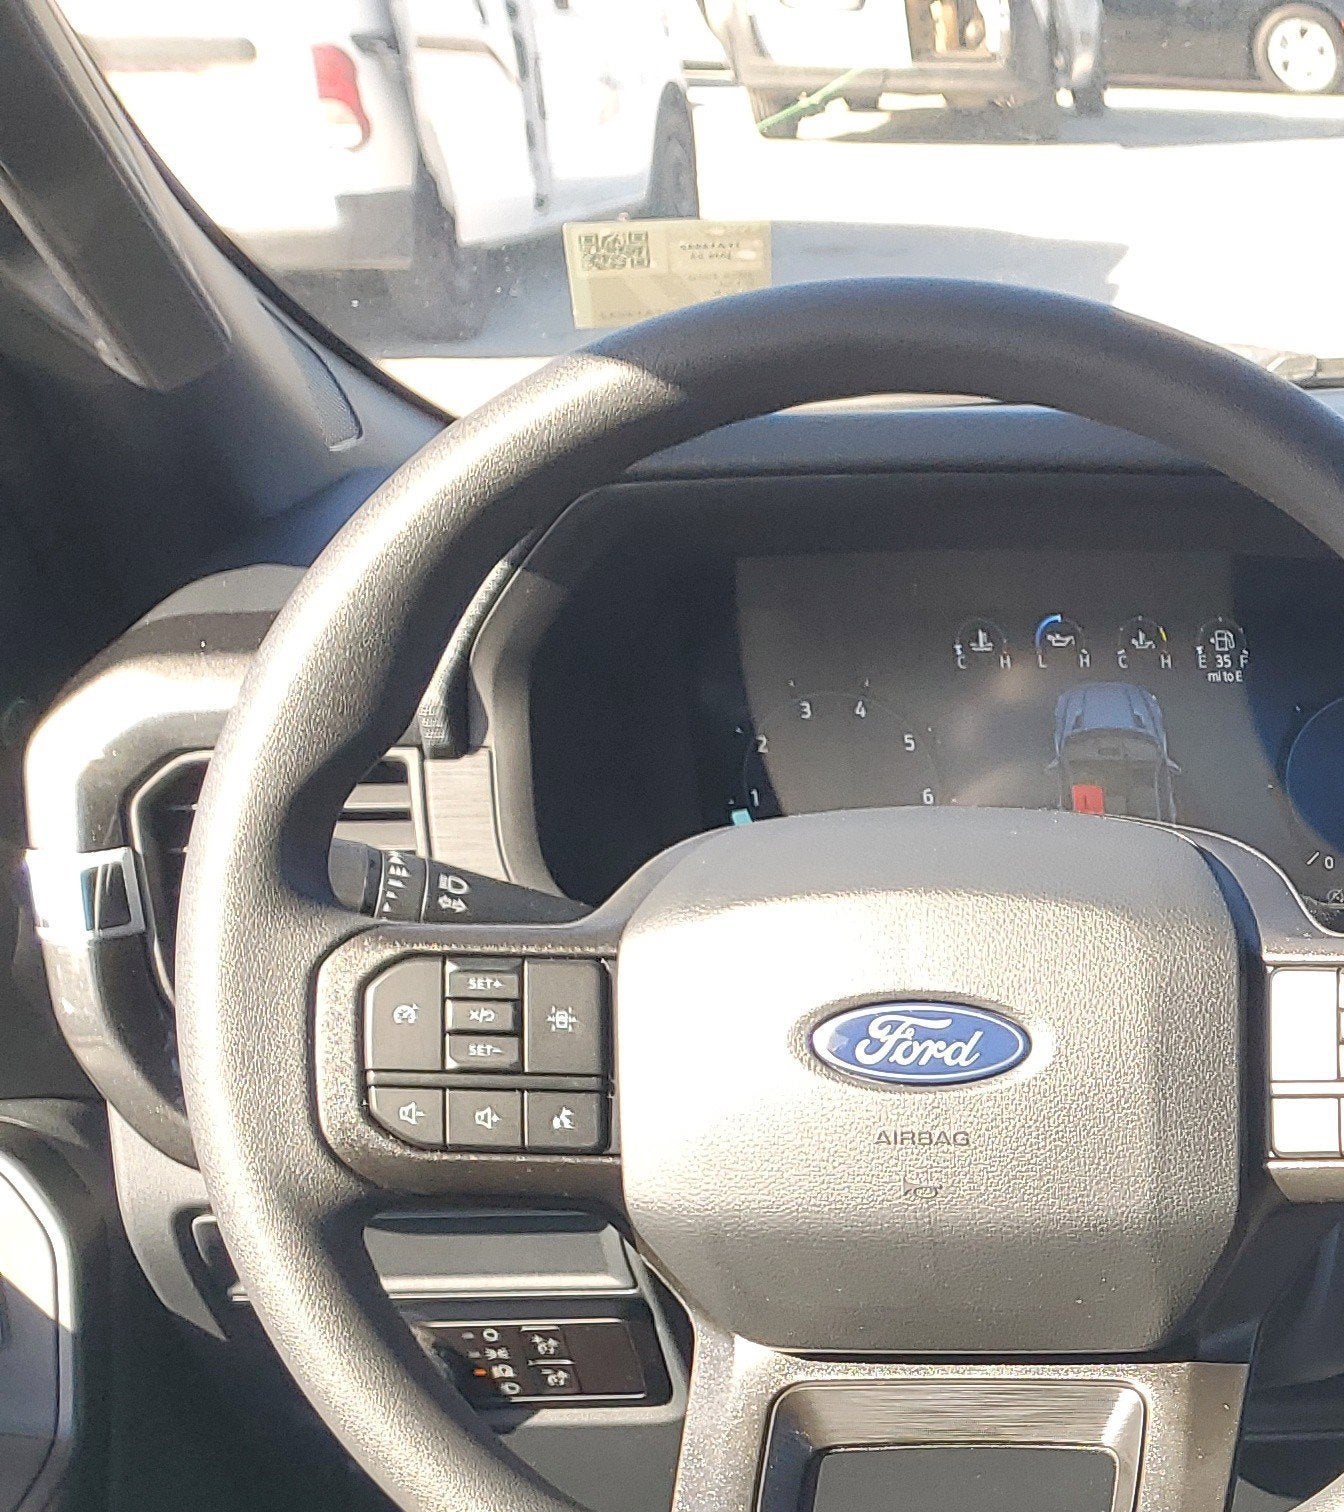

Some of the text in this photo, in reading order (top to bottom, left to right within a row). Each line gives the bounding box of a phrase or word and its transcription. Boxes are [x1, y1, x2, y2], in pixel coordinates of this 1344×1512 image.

[1000, 655, 1011, 670] H
[1038, 655, 1048, 669] L
[1079, 654, 1091, 668] H
[1160, 655, 1172, 669] H
[1215, 653, 1232, 669] 35
[800, 701, 812, 719] 3
[855, 701, 866, 718] 4
[757, 734, 769, 753] 2
[903, 734, 915, 752] 5
[750, 789, 760, 807] 1
[922, 788, 934, 806] 6
[1324, 855, 1334, 870] 0
[854, 1013, 984, 1068] Ford
[873, 1130, 971, 1148] AIRBAG
